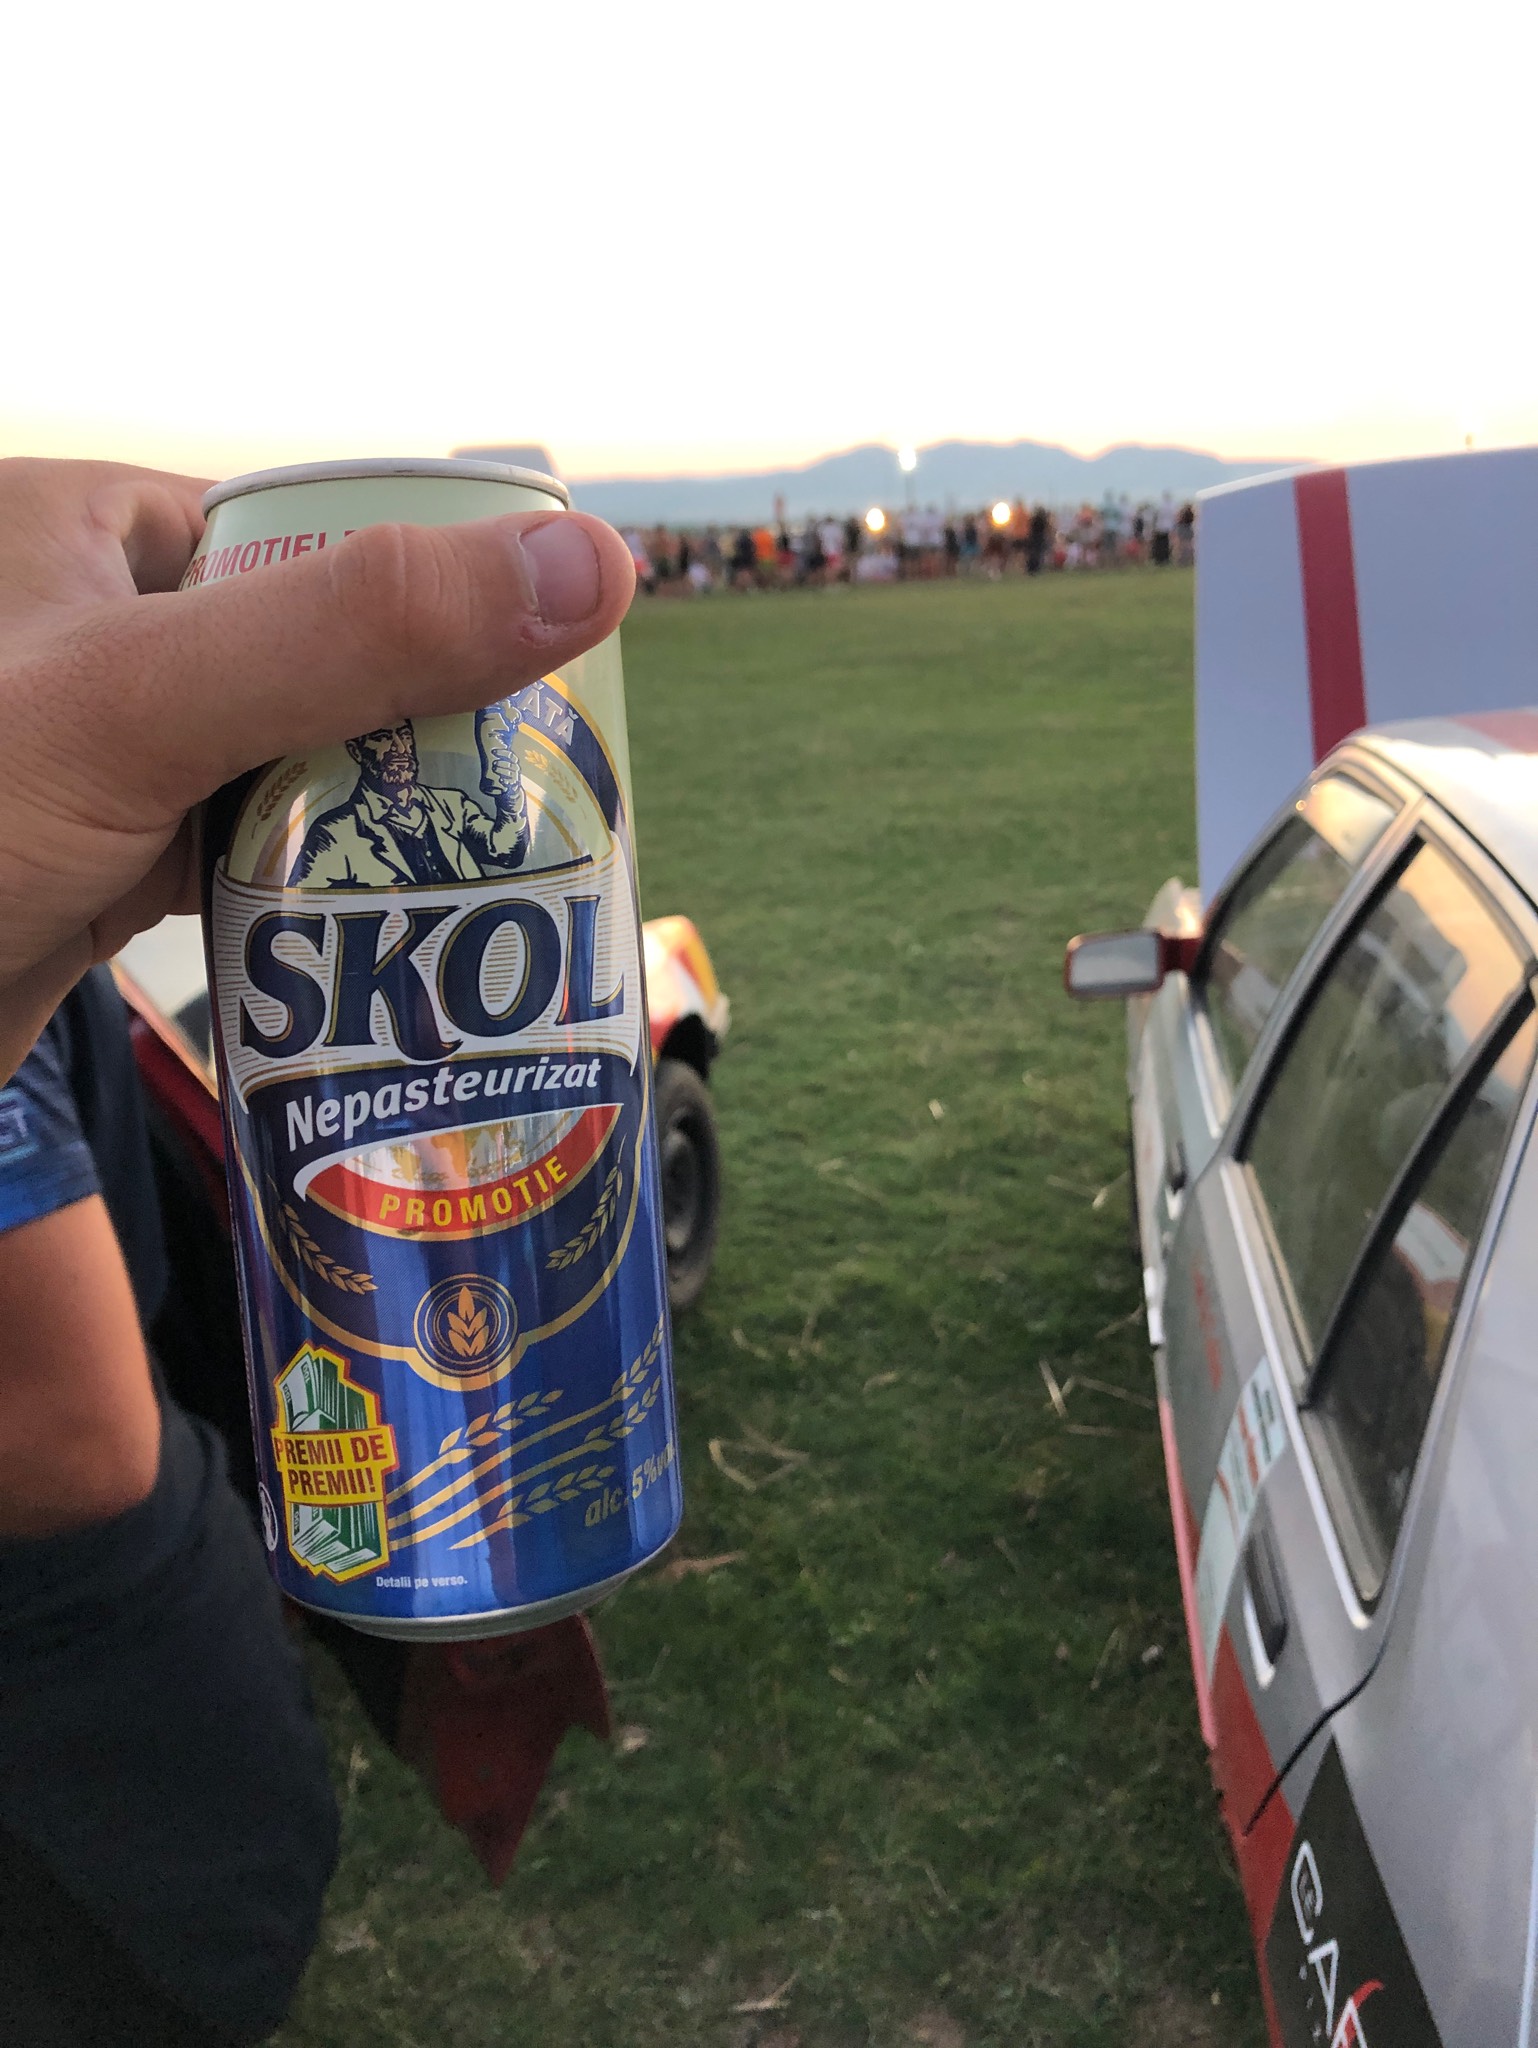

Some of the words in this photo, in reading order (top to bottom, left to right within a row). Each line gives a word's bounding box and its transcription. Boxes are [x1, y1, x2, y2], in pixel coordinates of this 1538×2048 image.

[240, 895, 625, 1061] SKOL
[286, 1056, 602, 1153] Nepasteurizat
[273, 1437, 344, 1465] PREMII
[350, 1434, 388, 1463] DE
[287, 1467, 376, 1496] PREMII!
[375, 1576, 412, 1588] Detalii
[414, 1577, 429, 1590] pe
[431, 1575, 468, 1588] verso.
